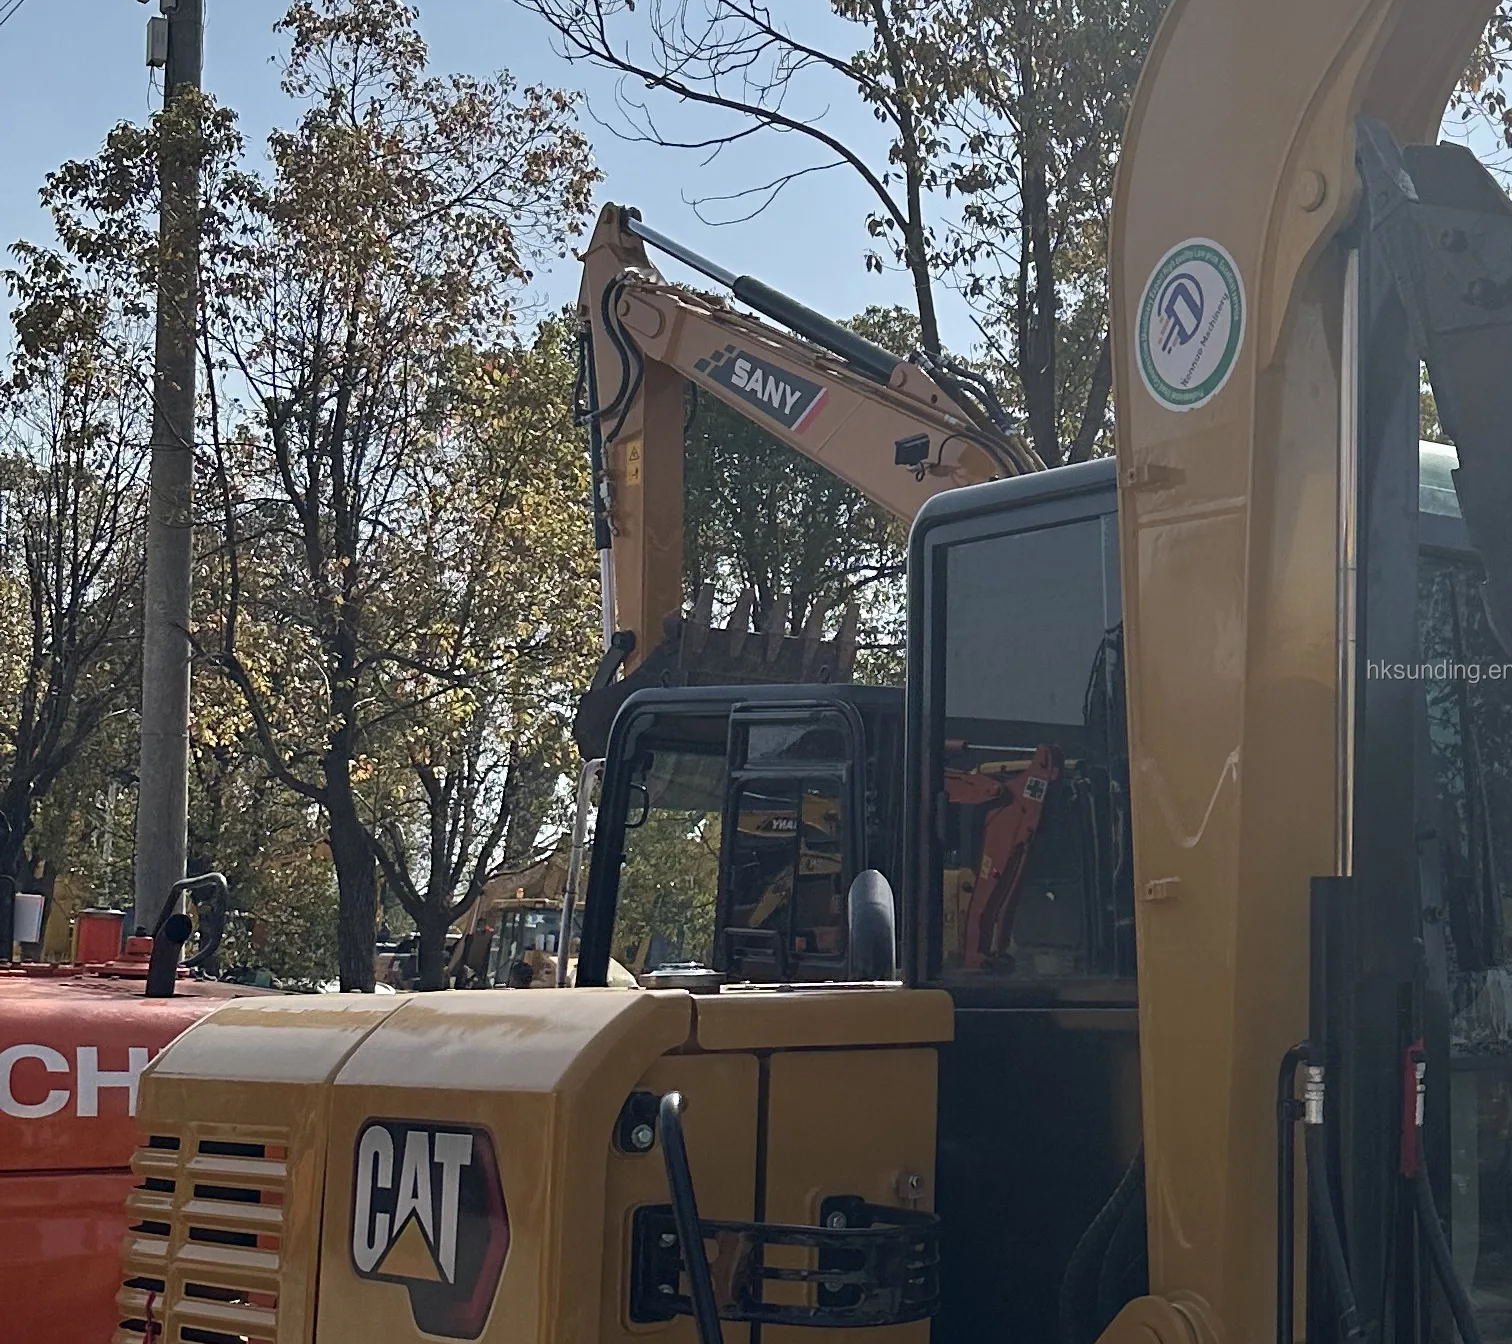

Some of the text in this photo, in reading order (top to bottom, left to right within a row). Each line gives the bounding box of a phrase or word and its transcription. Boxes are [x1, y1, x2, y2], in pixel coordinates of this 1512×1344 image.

[1200, 292, 1230, 347] Machinery
[731, 358, 801, 415] SANY
[353, 1125, 474, 1284] CAT
